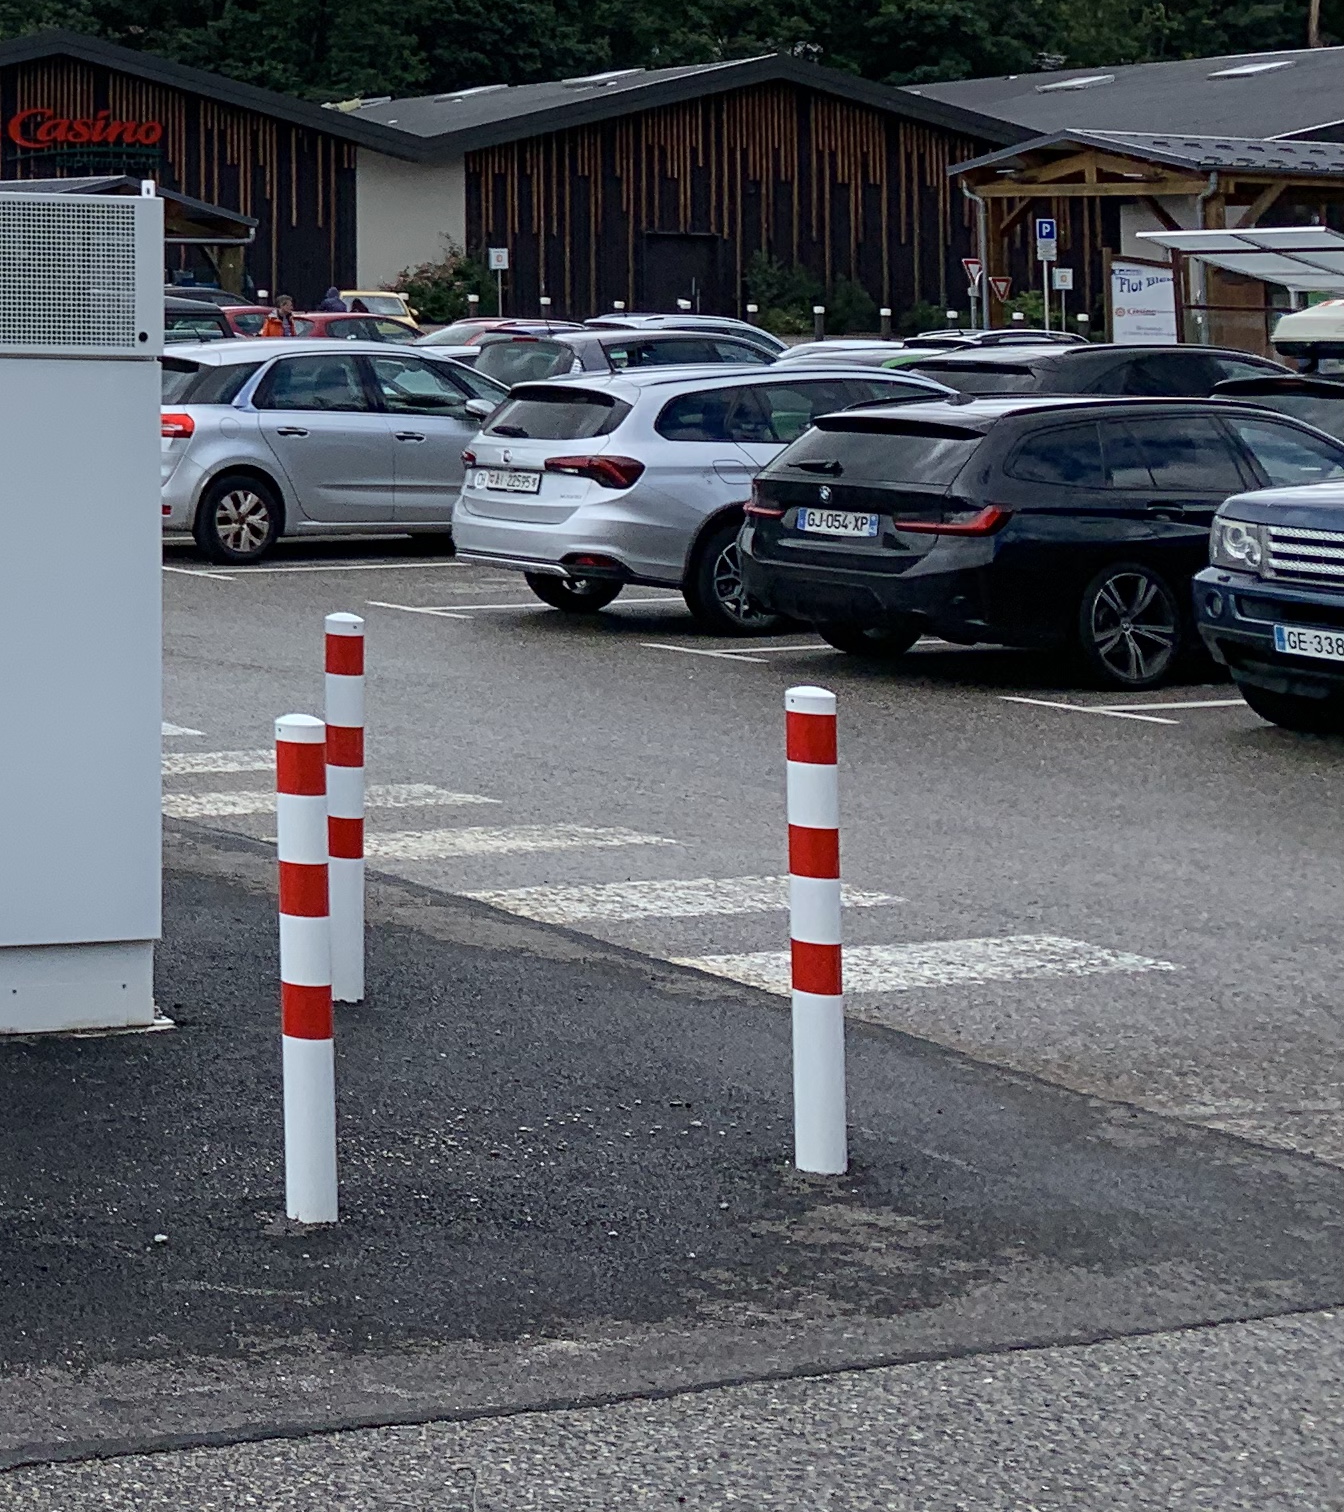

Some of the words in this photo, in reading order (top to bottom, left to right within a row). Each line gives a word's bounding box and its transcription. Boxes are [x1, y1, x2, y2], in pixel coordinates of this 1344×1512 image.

[8, 108, 162, 148] Casino
[1042, 223, 1051, 236] P
[1117, 276, 1142, 293] Flot
